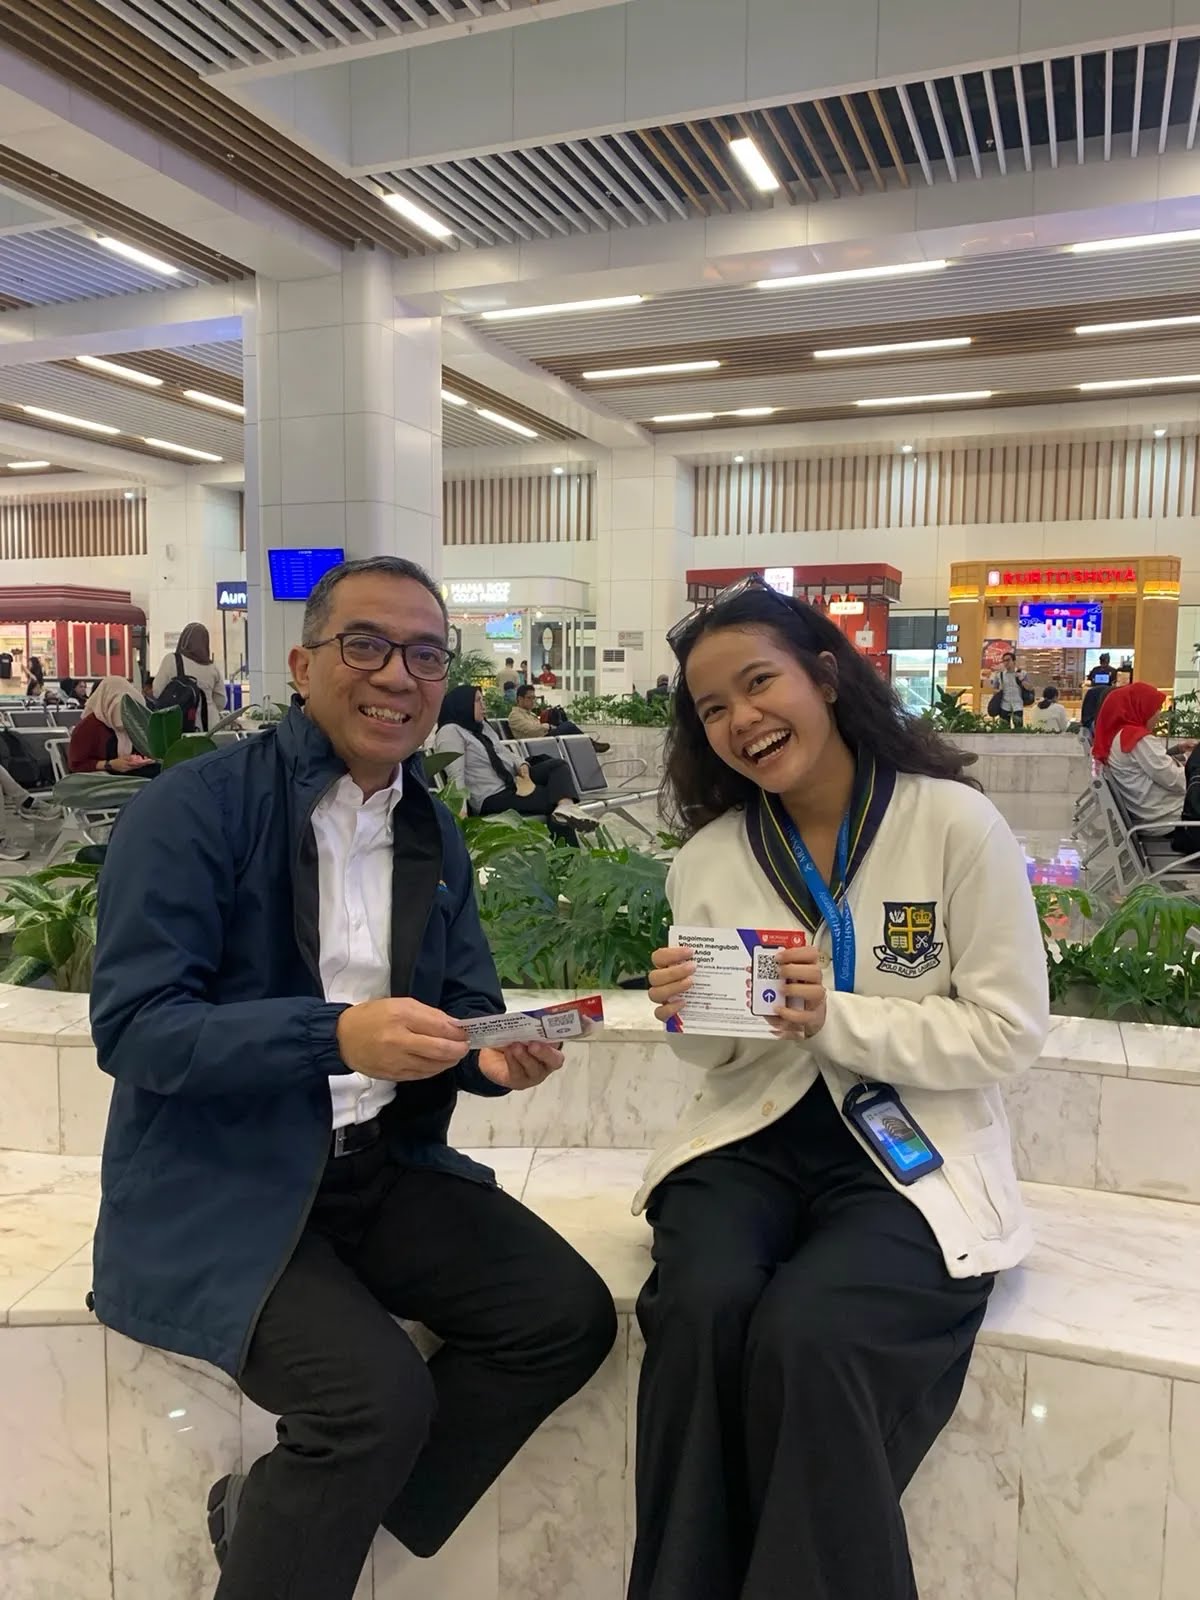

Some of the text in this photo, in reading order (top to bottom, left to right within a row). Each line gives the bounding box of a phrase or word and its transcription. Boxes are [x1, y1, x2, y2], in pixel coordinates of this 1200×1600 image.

[219, 590, 247, 605] Aun
[678, 934, 714, 942] Bagaimana
[678, 941, 739, 951] Whoosh mengubah
